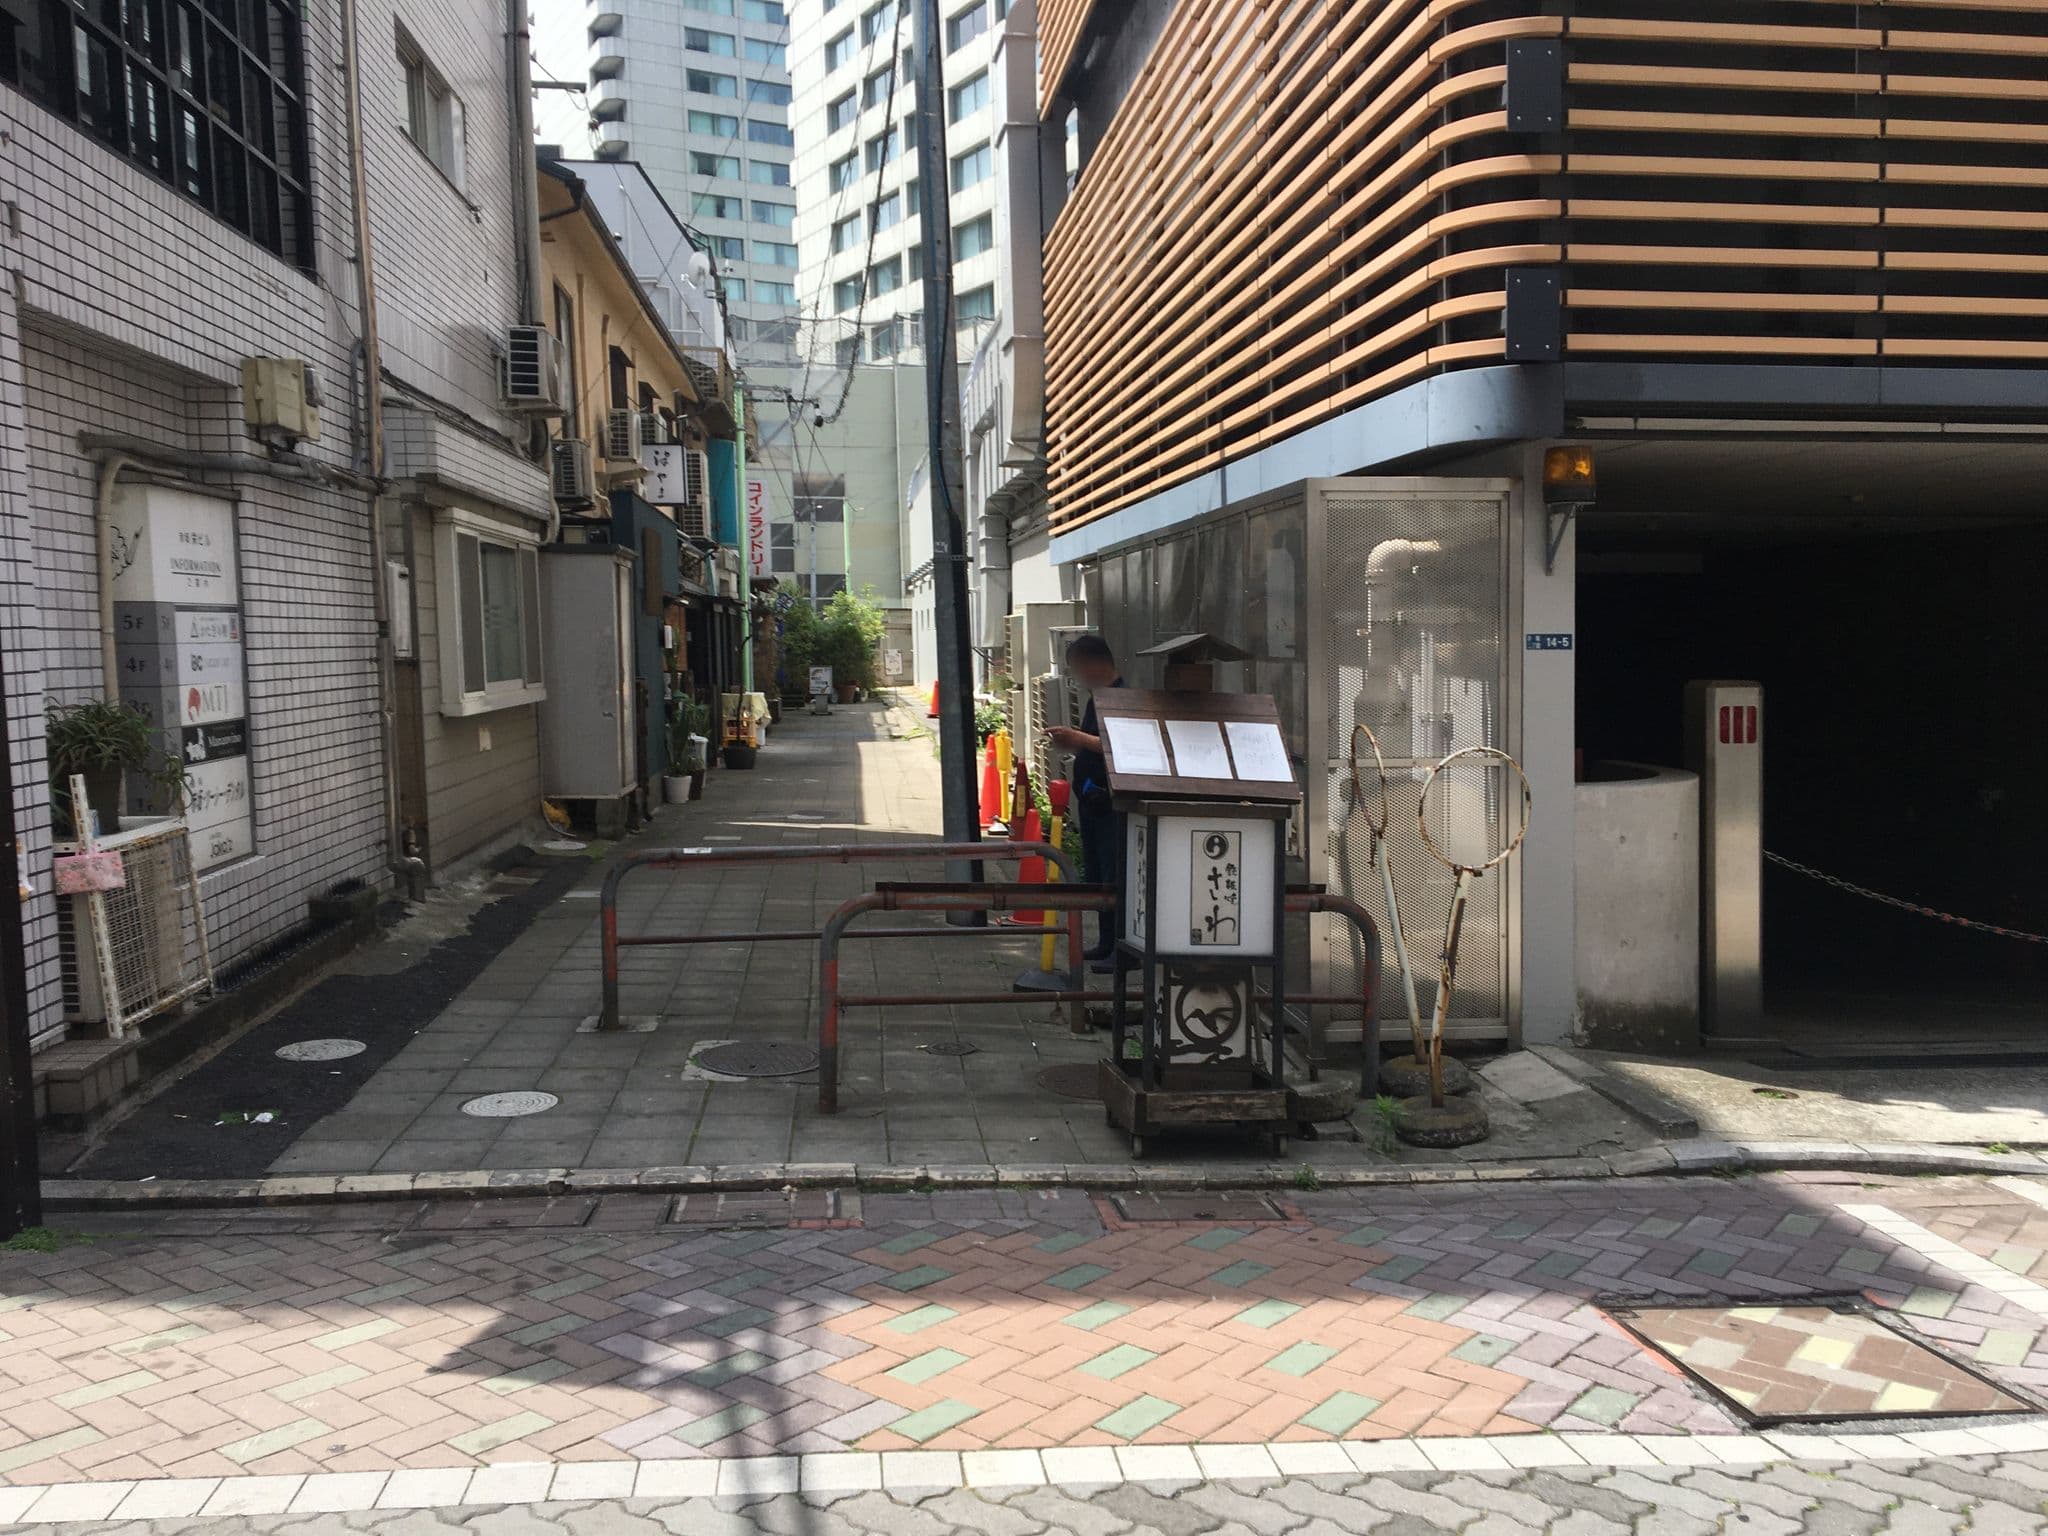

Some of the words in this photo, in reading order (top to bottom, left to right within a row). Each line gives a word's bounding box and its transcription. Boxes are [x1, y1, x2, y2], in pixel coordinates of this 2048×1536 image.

[748, 481, 763, 576] コインランドリー
[1546, 637, 1569, 648] 14-5
